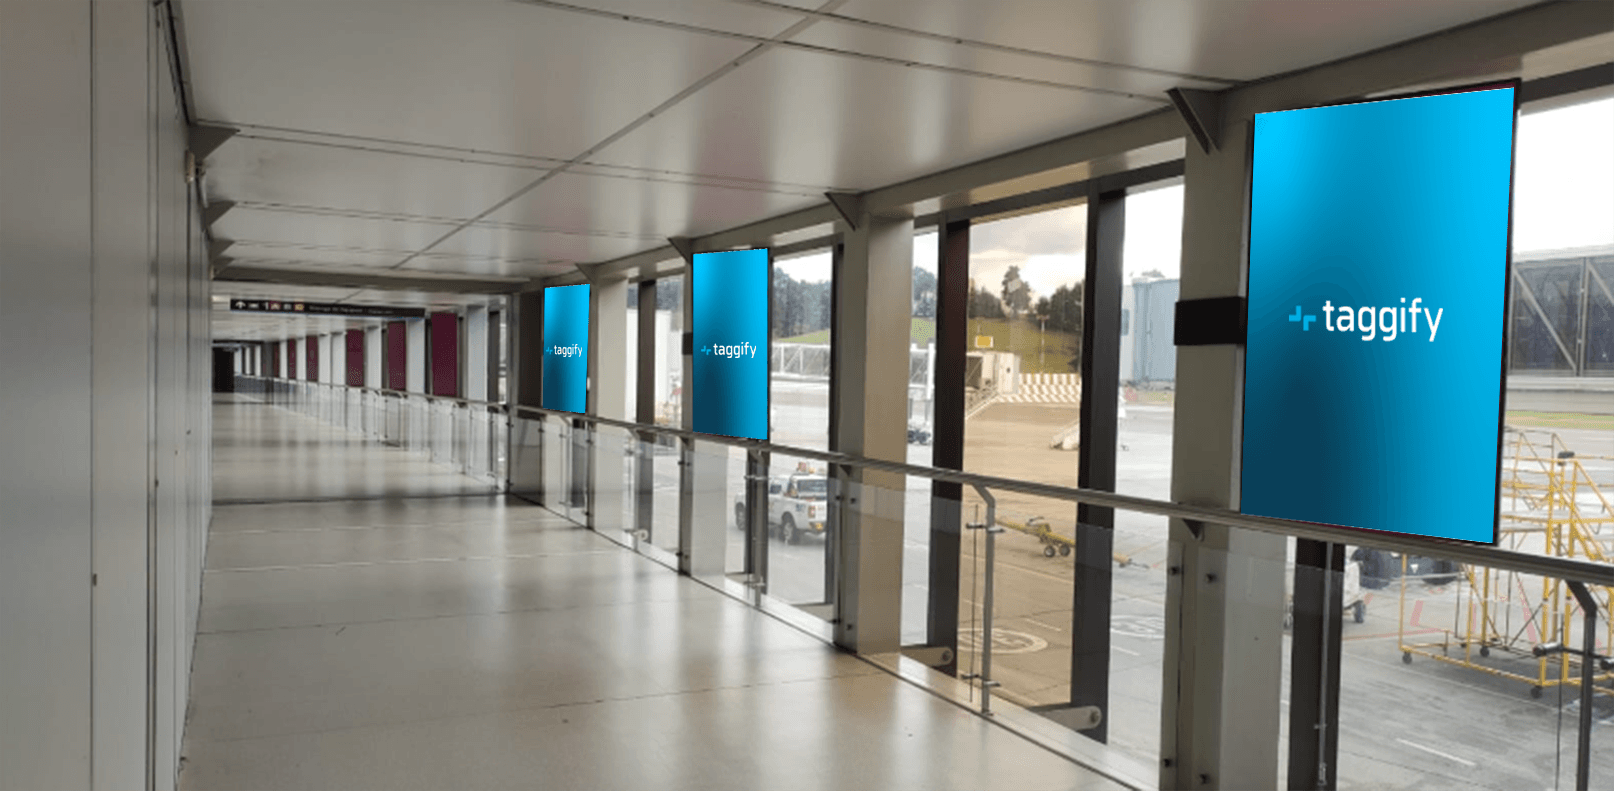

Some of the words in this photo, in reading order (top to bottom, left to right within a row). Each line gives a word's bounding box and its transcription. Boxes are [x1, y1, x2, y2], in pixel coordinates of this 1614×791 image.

[1323, 298, 1443, 342] taggify
[554, 344, 582, 357] taggify
[713, 342, 756, 358] taggify
